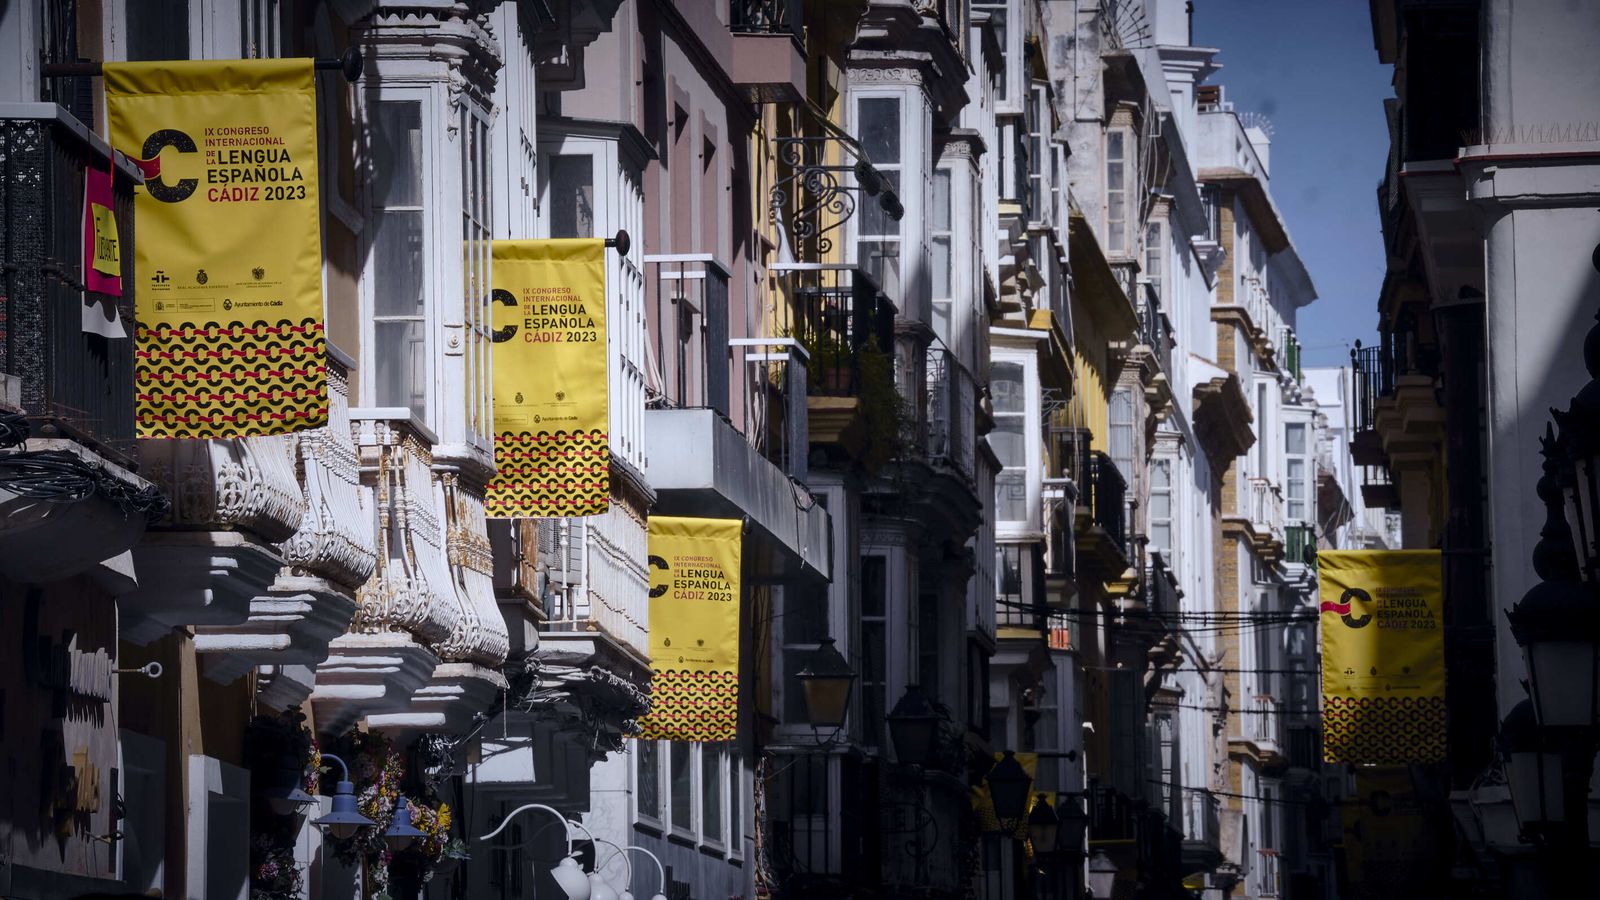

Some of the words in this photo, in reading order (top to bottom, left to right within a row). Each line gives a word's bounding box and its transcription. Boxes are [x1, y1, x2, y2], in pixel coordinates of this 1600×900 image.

[217, 127, 270, 136] CONGRESO
[206, 138, 285, 146] INTERNACIONAL
[218, 149, 291, 164] LENGUA
[208, 164, 303, 183] ESPAÑOLA
[208, 184, 260, 202] CÁDIZ
[264, 186, 306, 200] 2023
[532, 304, 586, 315] LENGUA
[524, 315, 595, 328] ESPAÑOLA
[524, 329, 562, 342] CÁDIZ
[566, 332, 596, 342] 2023
[681, 570, 724, 579] LENGUA
[674, 578, 730, 590] ESPAÑOLA
[674, 588, 704, 600] CÁDIZ
[708, 592, 732, 601] 2023
[1384, 600, 1427, 608] LENGUA
[1410, 620, 1436, 628] 2023
